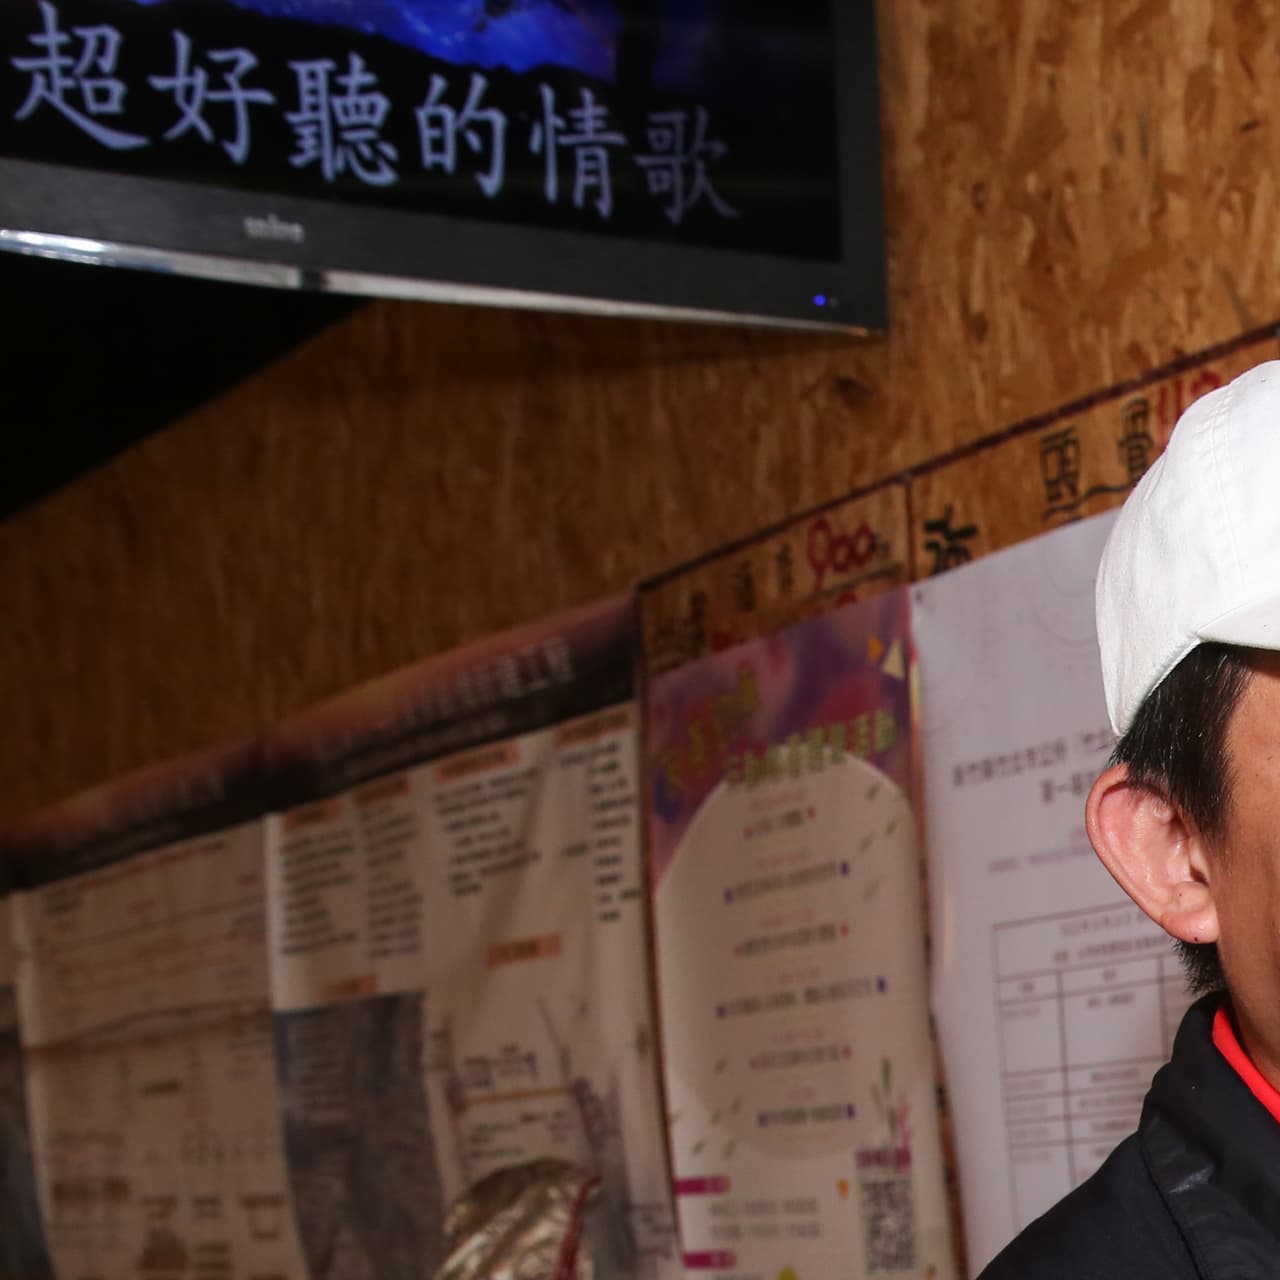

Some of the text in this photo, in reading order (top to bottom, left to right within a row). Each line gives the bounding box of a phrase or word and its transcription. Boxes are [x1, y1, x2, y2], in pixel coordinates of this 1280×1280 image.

[11, 1, 741, 226] 超好聽的情歌
